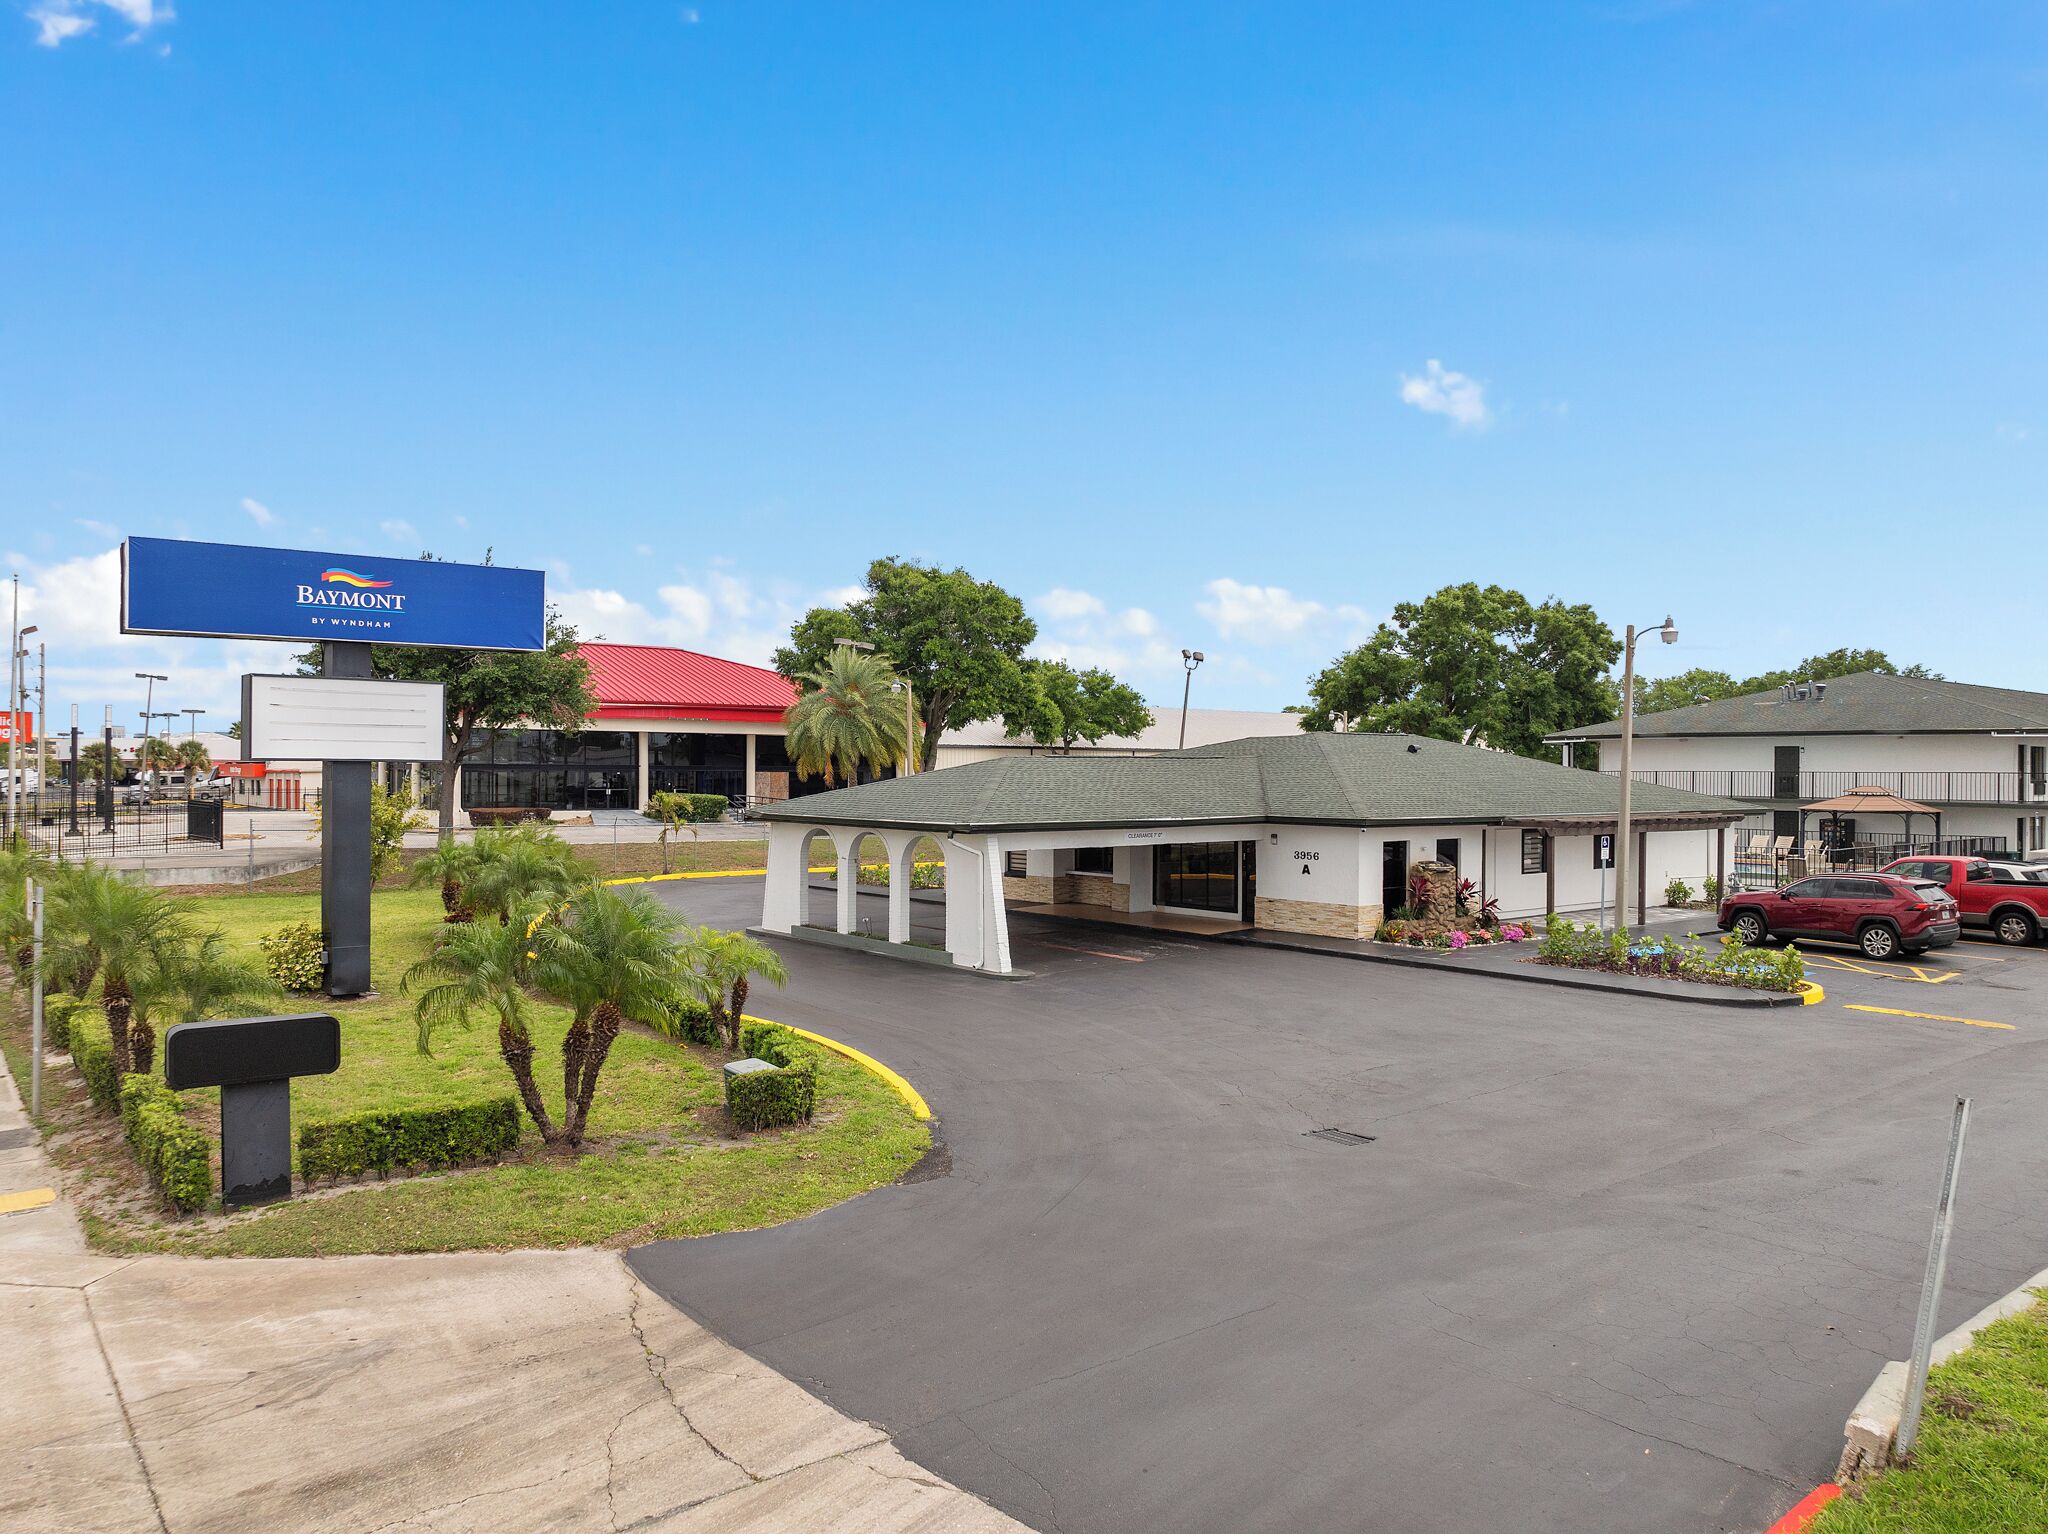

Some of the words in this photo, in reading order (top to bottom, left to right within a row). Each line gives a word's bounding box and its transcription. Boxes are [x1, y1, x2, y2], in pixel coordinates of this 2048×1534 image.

[296, 585, 405, 610] BAYMONT
[331, 618, 391, 628] WYNDHAM
[1293, 850, 1320, 861] 3956
[1301, 864, 1311, 875] A
